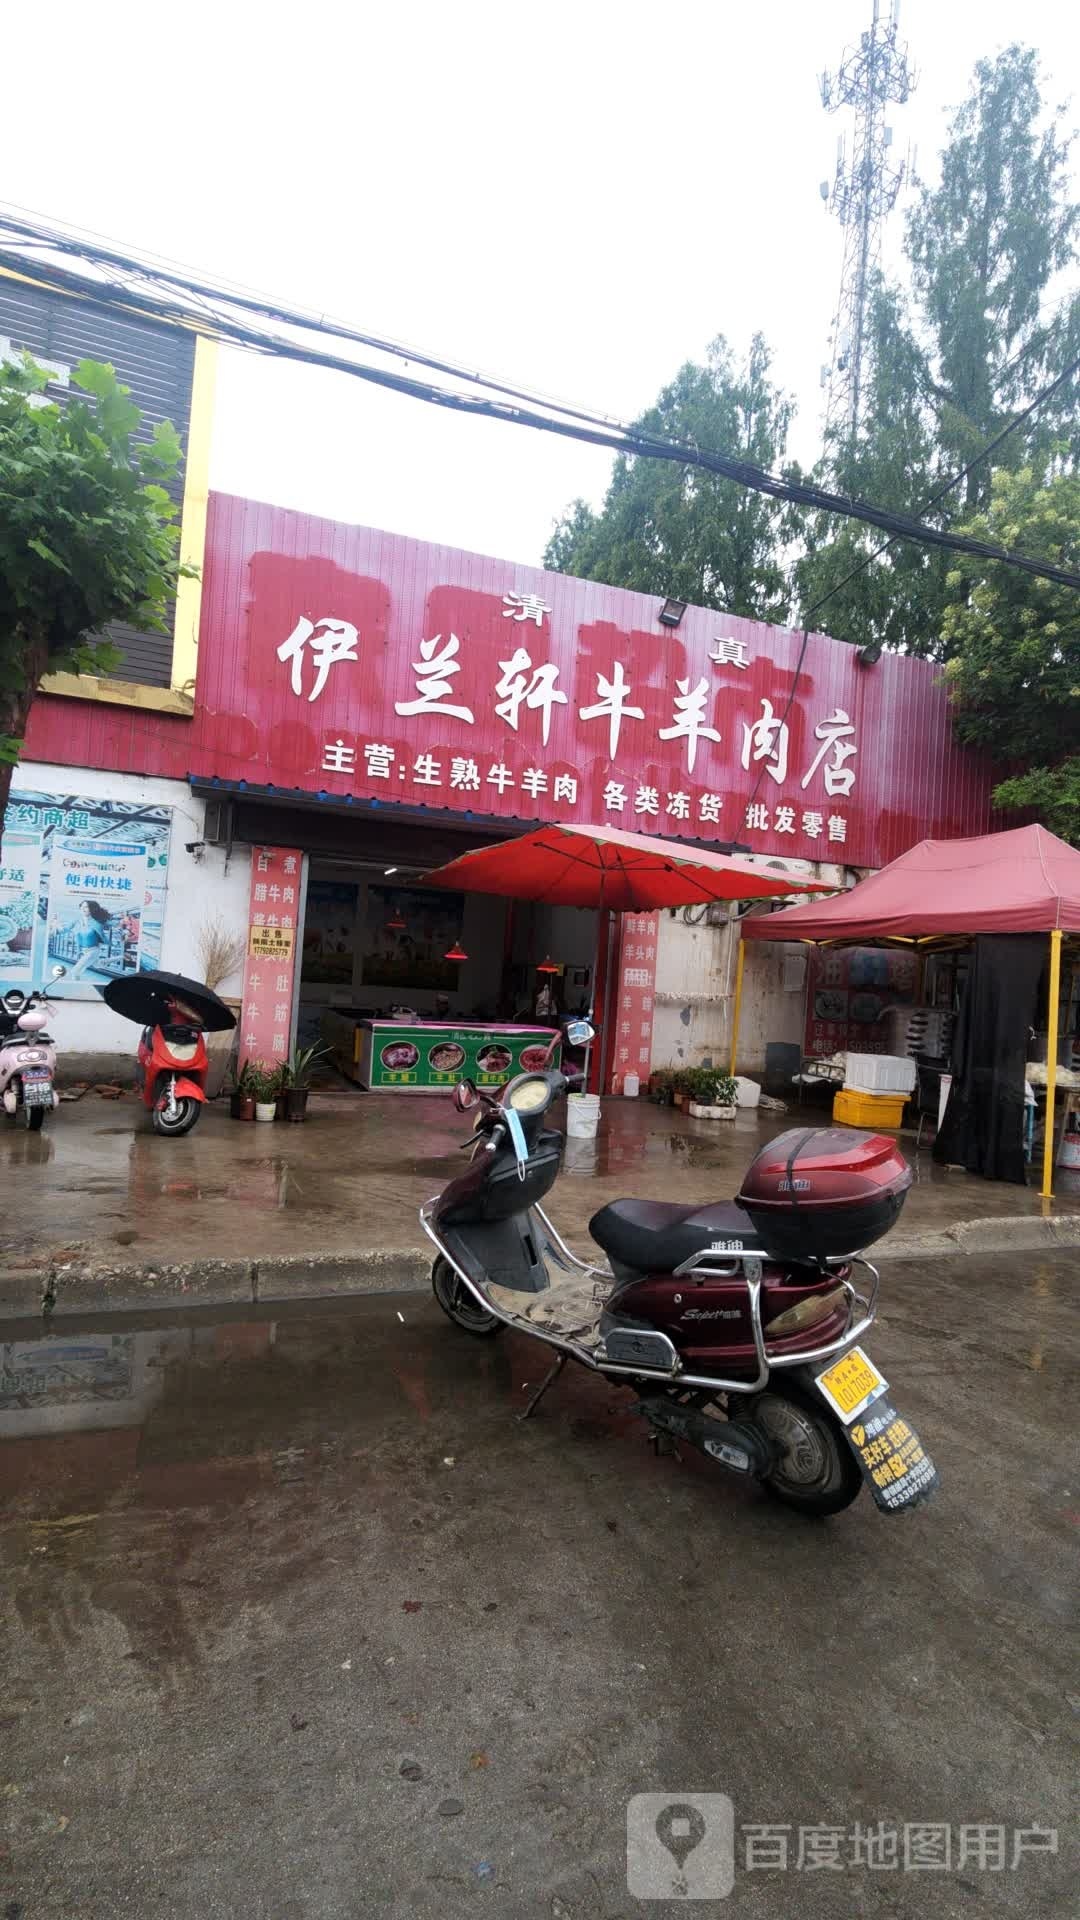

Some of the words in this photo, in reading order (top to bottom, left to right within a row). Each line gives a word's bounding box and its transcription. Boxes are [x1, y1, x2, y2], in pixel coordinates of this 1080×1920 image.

[502, 589, 552, 629] 清
[708, 636, 751, 670] 真
[276, 614, 858, 798] 伊兰轩牛羊肉店
[602, 780, 724, 825] 各类冻货
[745, 802, 848, 843] 批发零售
[65, 873, 132, 890] 便利快捷
[254, 883, 295, 904] 腊牛肉
[624, 944, 655, 961] 羊头肉
[249, 973, 289, 992] 牛肚
